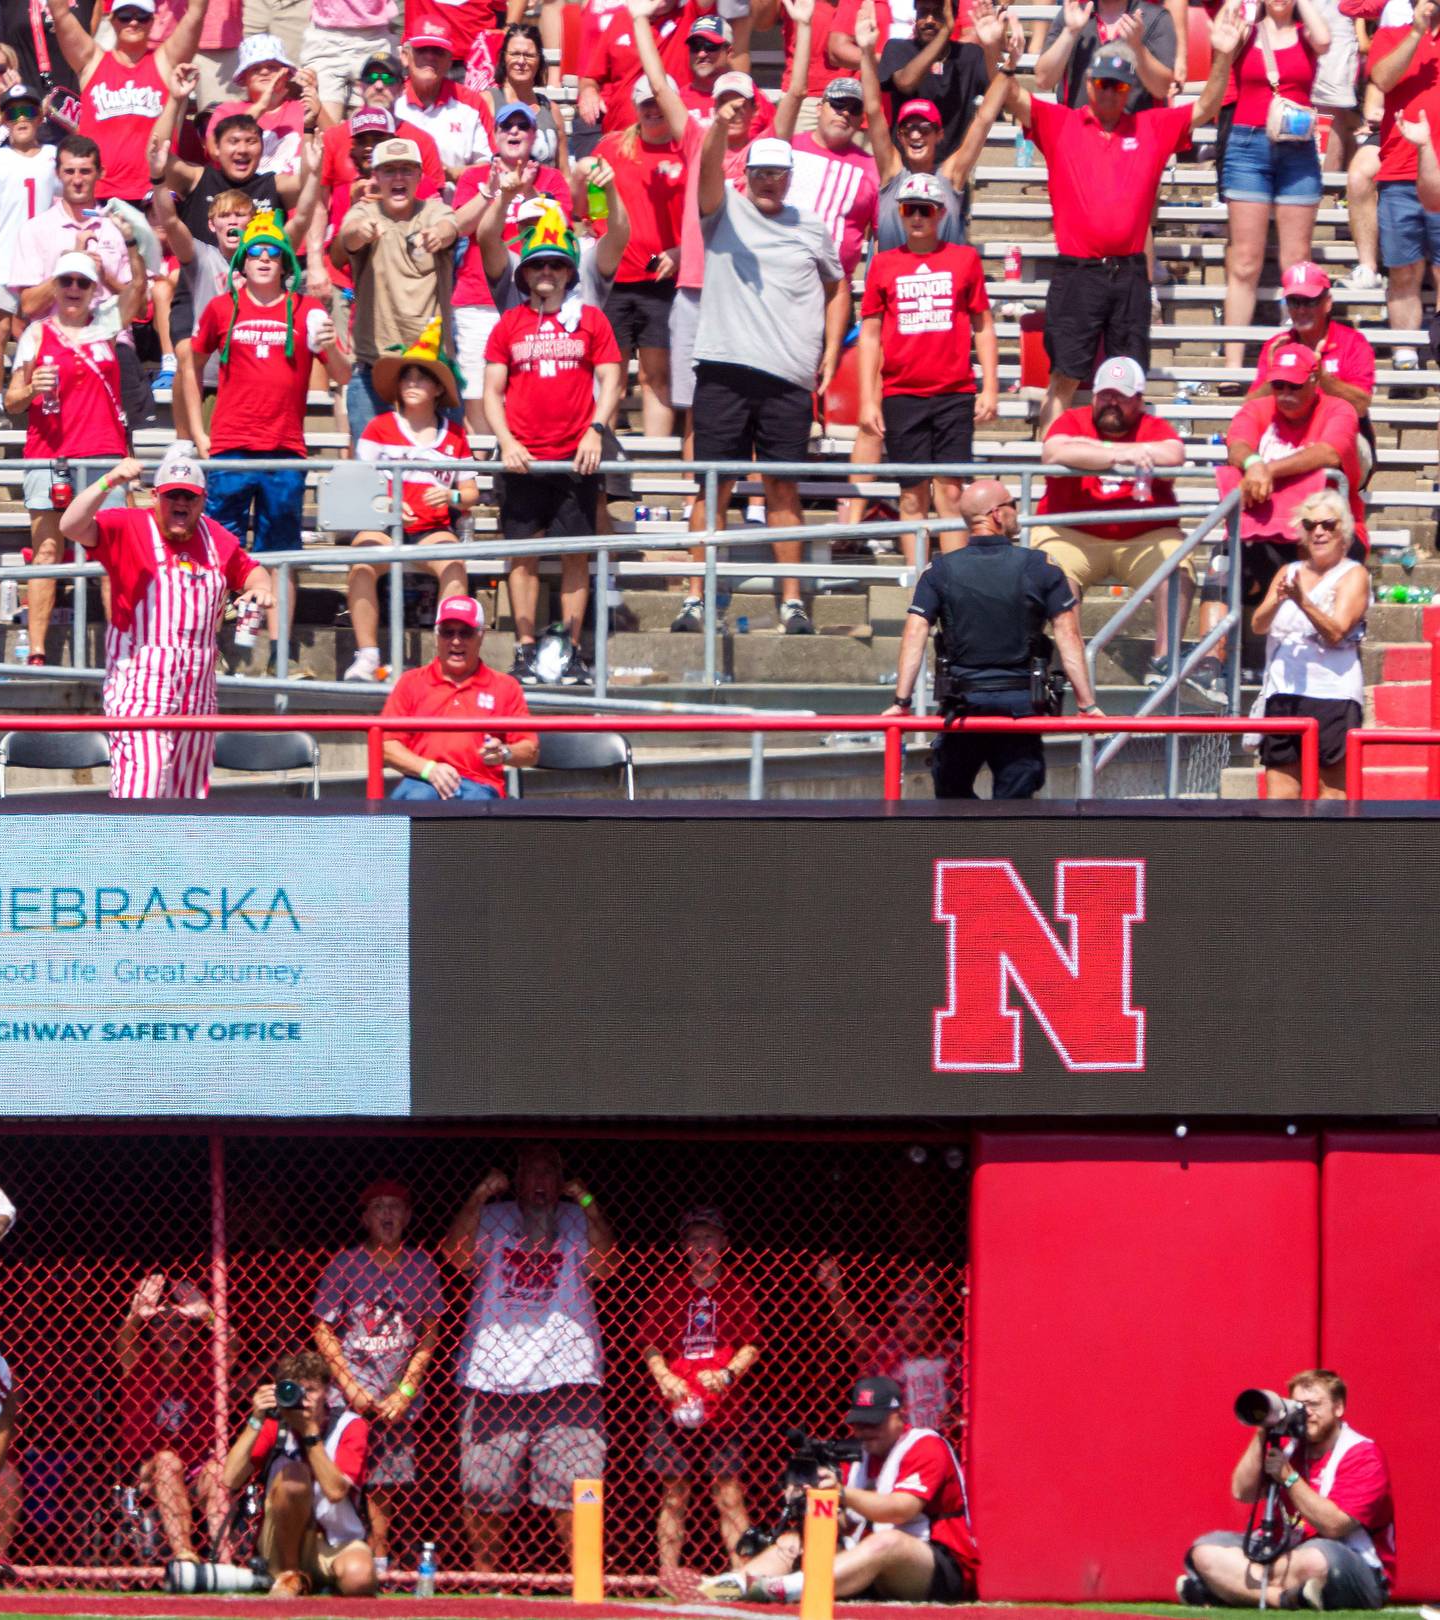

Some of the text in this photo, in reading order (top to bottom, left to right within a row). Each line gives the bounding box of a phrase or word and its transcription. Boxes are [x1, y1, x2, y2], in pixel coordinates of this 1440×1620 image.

[23, 177, 36, 220] 1
[541, 227, 559, 245] N
[1292, 265, 1307, 284] N
[896, 280, 952, 299] HONOR
[898, 309, 952, 325] SUPPORT
[540, 361, 556, 378] N
[113, 957, 187, 984] Great
[933, 858, 1146, 1072] N
[101, 1021, 200, 1042] SAFETY
[207, 1021, 302, 1042] OFFICE
[813, 1499, 834, 1518] N
